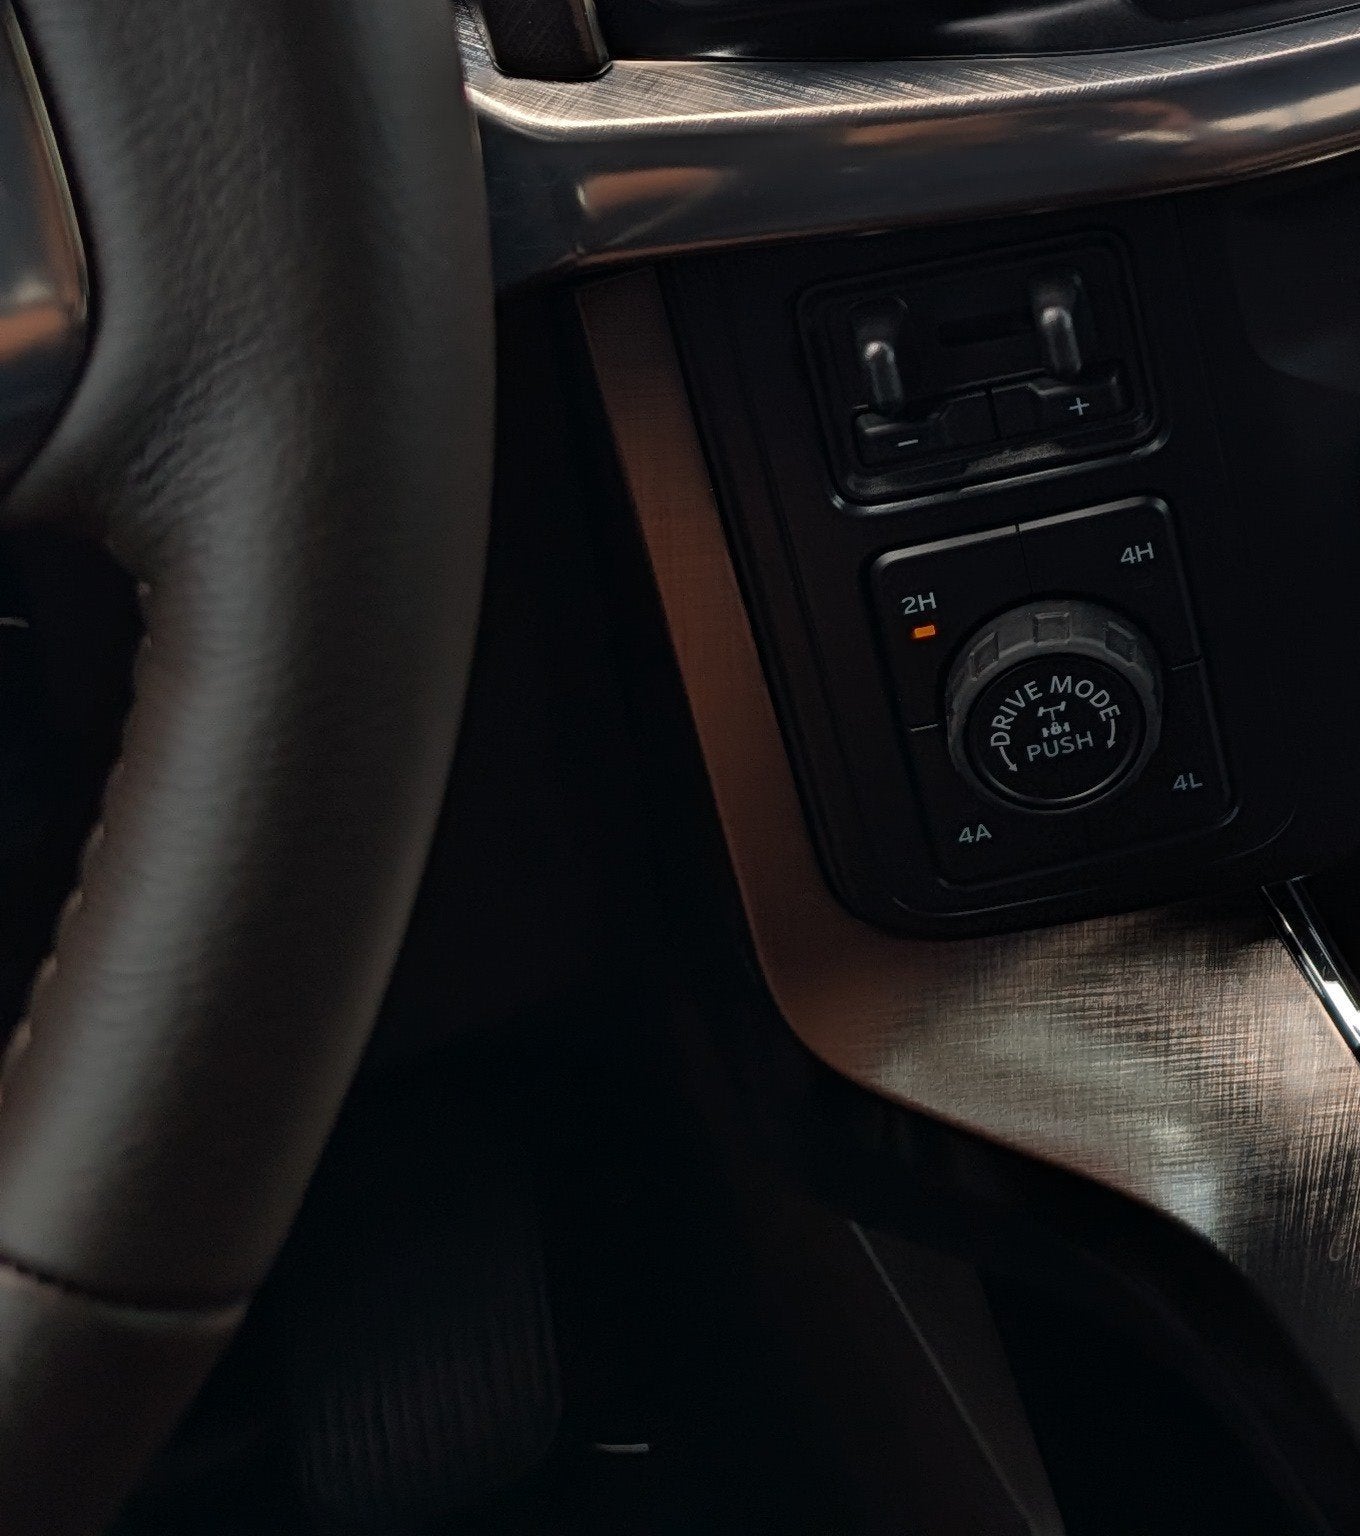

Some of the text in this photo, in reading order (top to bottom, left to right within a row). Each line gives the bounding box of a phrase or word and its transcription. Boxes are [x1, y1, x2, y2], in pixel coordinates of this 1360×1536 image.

[1121, 542, 1155, 564] 4H
[902, 592, 937, 615] 2H
[991, 676, 1120, 747] DRIVE MODE
[1027, 732, 1093, 761] PUSH
[1173, 772, 1203, 791] 4L
[958, 824, 992, 843] 4A
